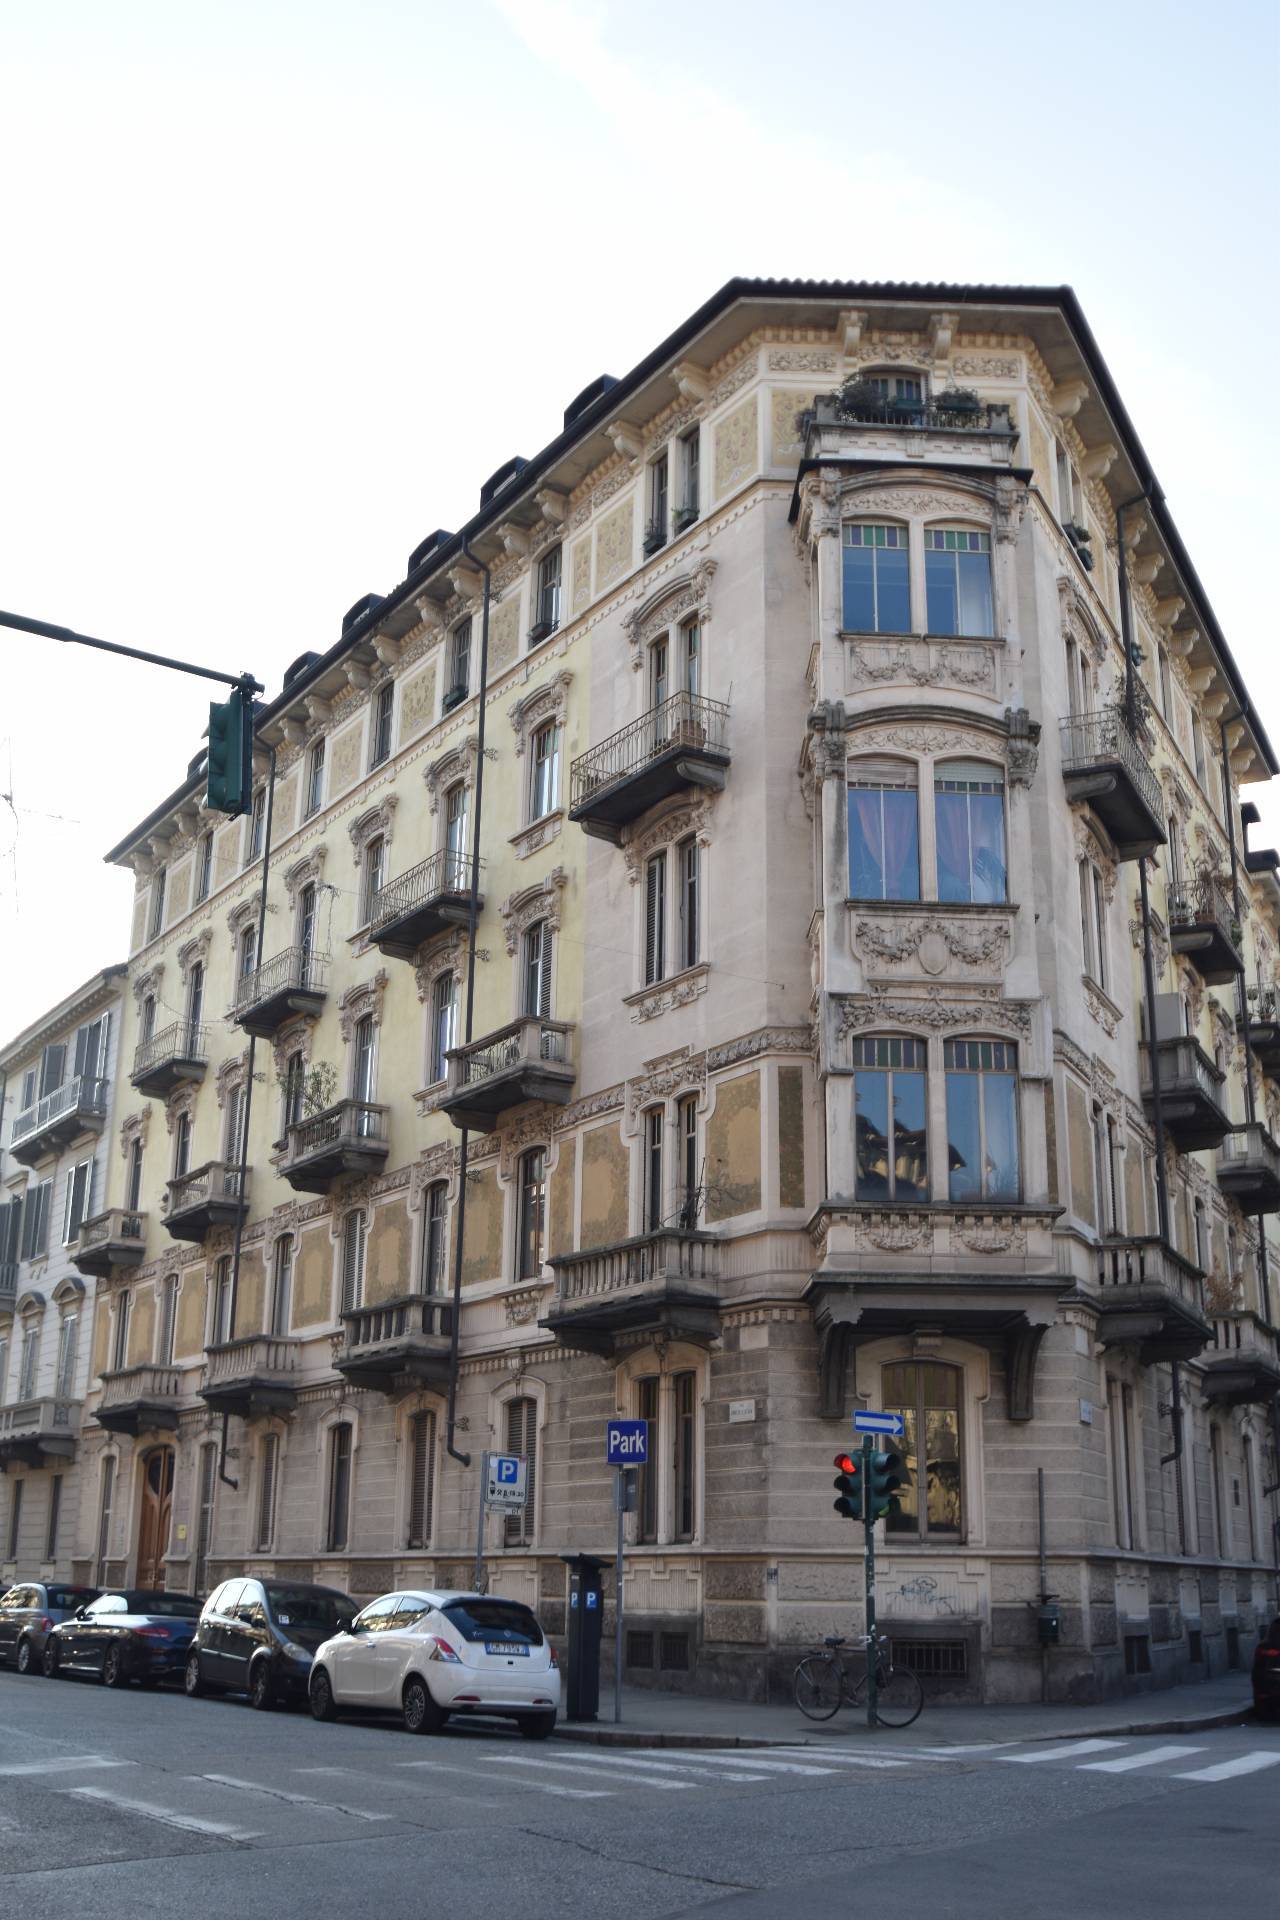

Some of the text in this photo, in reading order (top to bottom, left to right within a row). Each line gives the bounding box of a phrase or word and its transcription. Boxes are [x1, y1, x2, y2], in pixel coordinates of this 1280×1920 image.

[610, 1430, 645, 1454] Park
[501, 1461, 514, 1481] P
[571, 1592, 578, 1606] P
[587, 1592, 596, 1606] P
